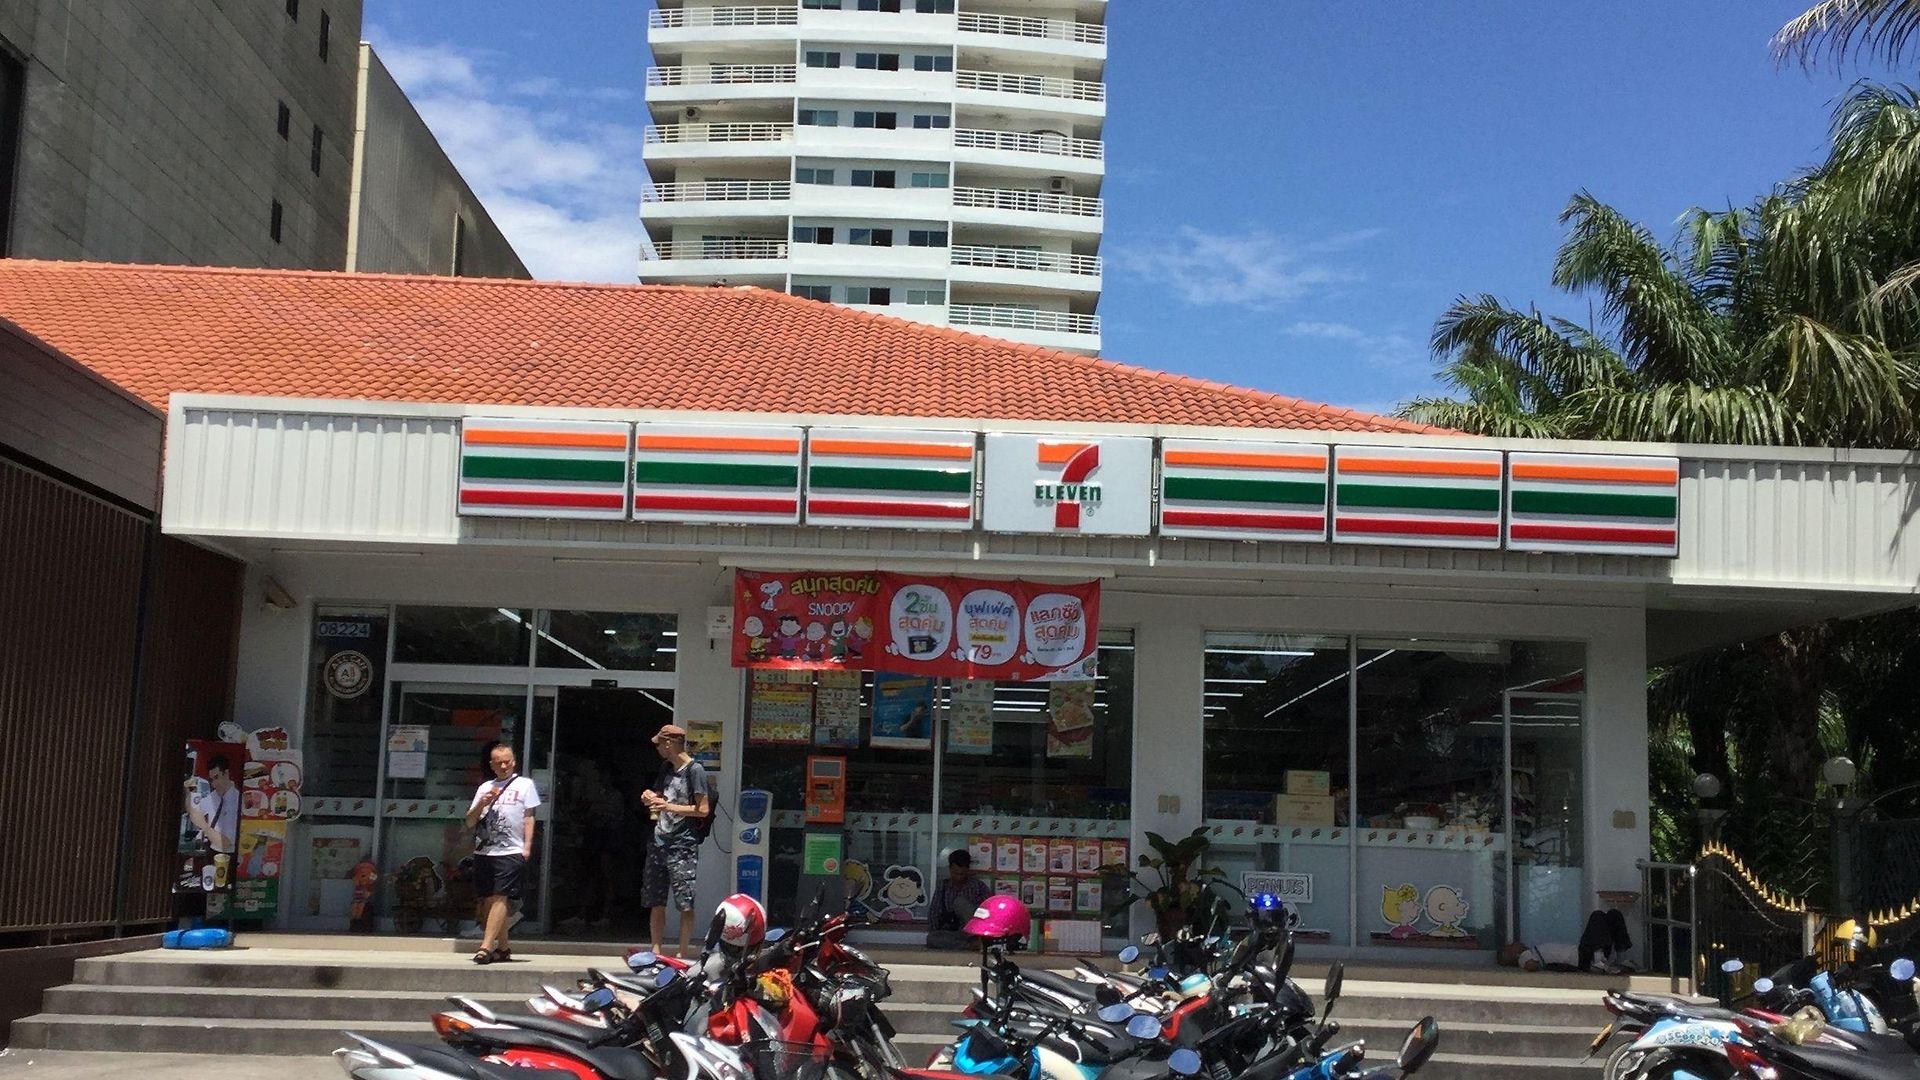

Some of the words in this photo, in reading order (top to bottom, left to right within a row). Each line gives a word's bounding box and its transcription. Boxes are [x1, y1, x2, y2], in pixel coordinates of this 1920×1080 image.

[1038, 442, 1099, 528] 7
[808, 601, 855, 616] SNOOPY
[971, 644, 992, 659] 79
